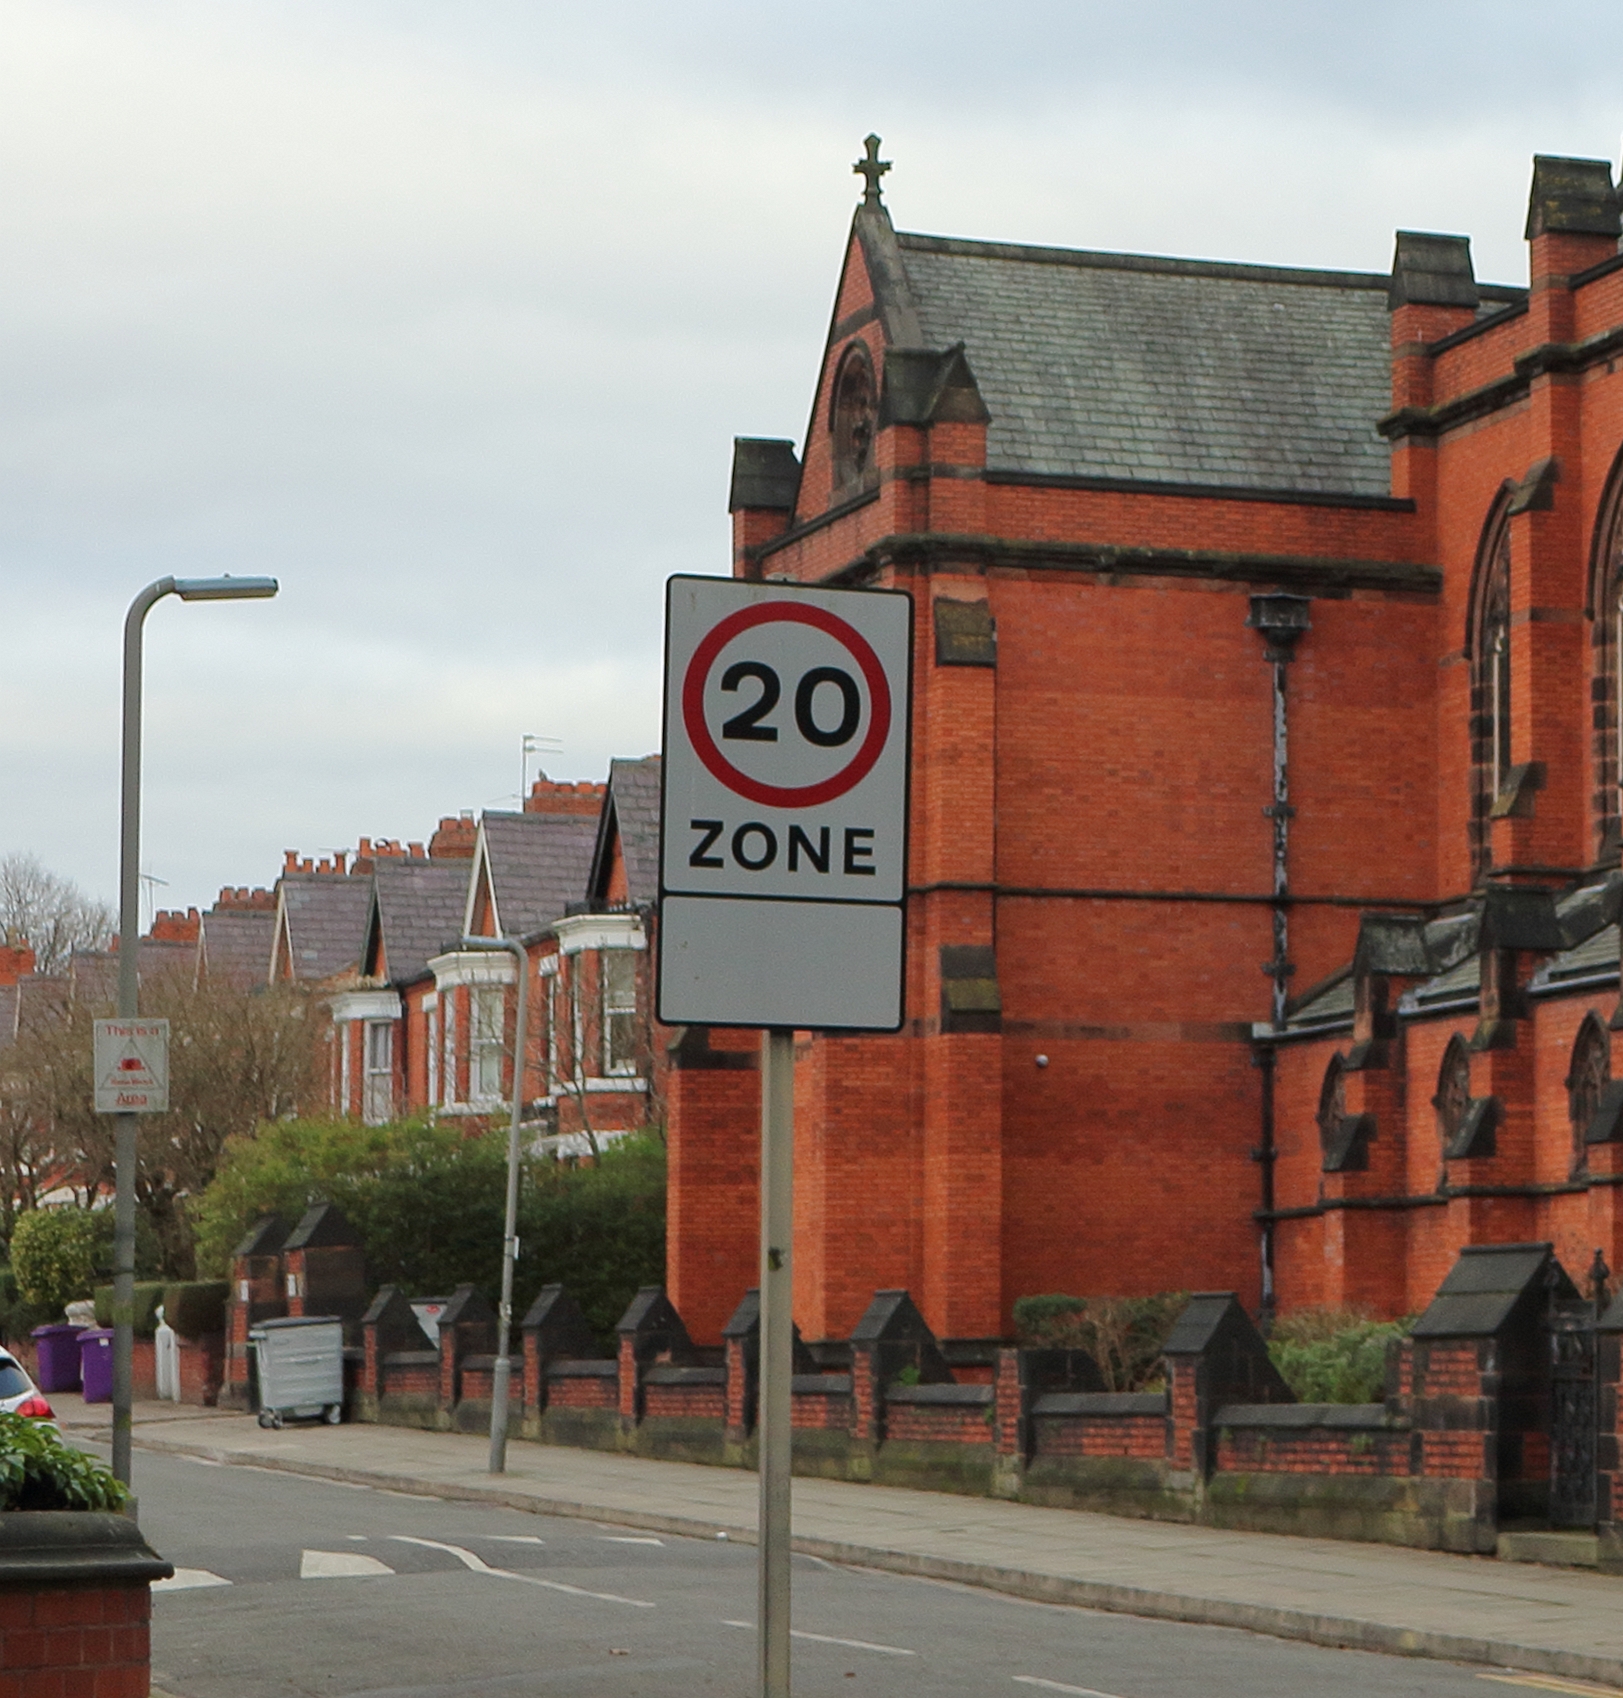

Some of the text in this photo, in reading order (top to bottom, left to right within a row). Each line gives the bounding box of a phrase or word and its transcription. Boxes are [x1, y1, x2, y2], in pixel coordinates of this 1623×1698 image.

[720, 660, 861, 748] 20
[688, 818, 877, 876] ZONE
[116, 1093, 148, 1106] Area
